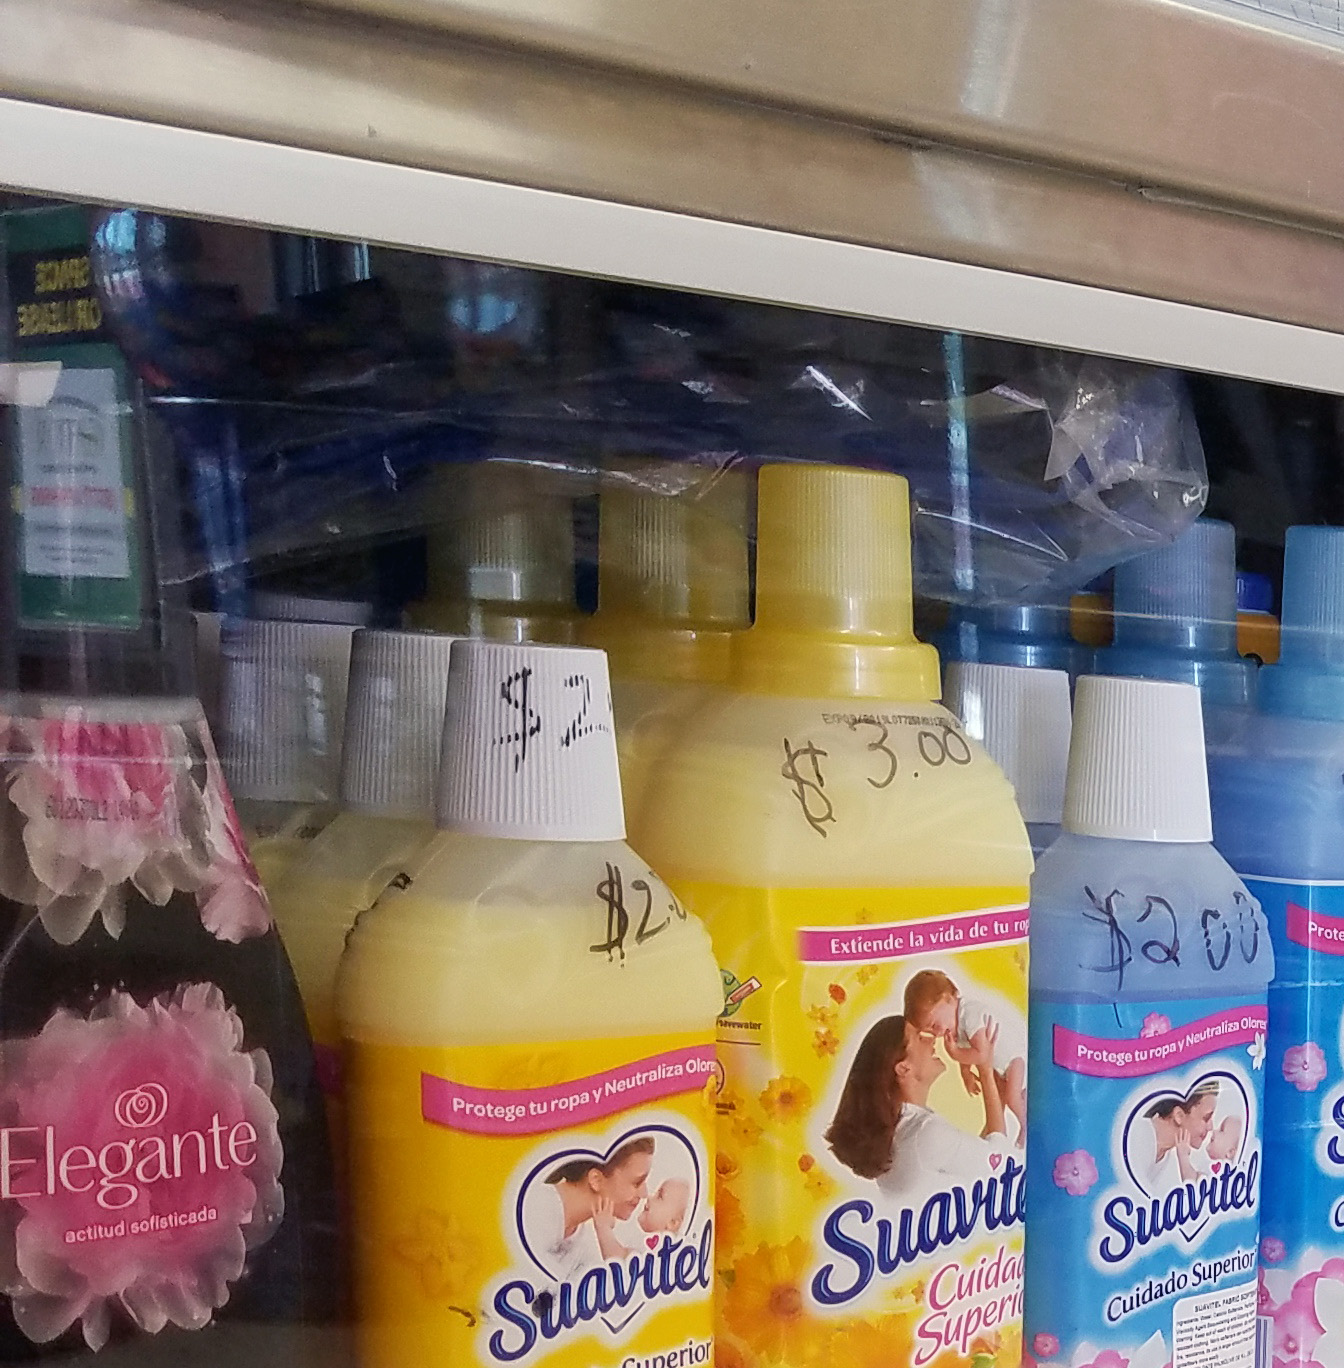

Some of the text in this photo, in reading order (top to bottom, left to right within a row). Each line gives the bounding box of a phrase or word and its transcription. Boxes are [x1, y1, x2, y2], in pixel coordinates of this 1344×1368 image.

[830, 934, 904, 956] Extiende
[909, 930, 925, 948] la
[929, 924, 964, 944] vida
[969, 921, 989, 939] de
[993, 916, 1011, 935] tu
[1077, 1018, 1240, 1067] Protege tu ropa y Neutraliza
[452, 1064, 684, 1122] Protege tu ropa y Neutraliza
[0, 1112, 259, 1211] Elegante
[64, 1205, 218, 1244] actitud sofisticada
[1099, 1150, 1259, 1263] Suavitel
[489, 1218, 714, 1361] Suavitel
[1106, 1249, 1256, 1322] Cuidado Superior
